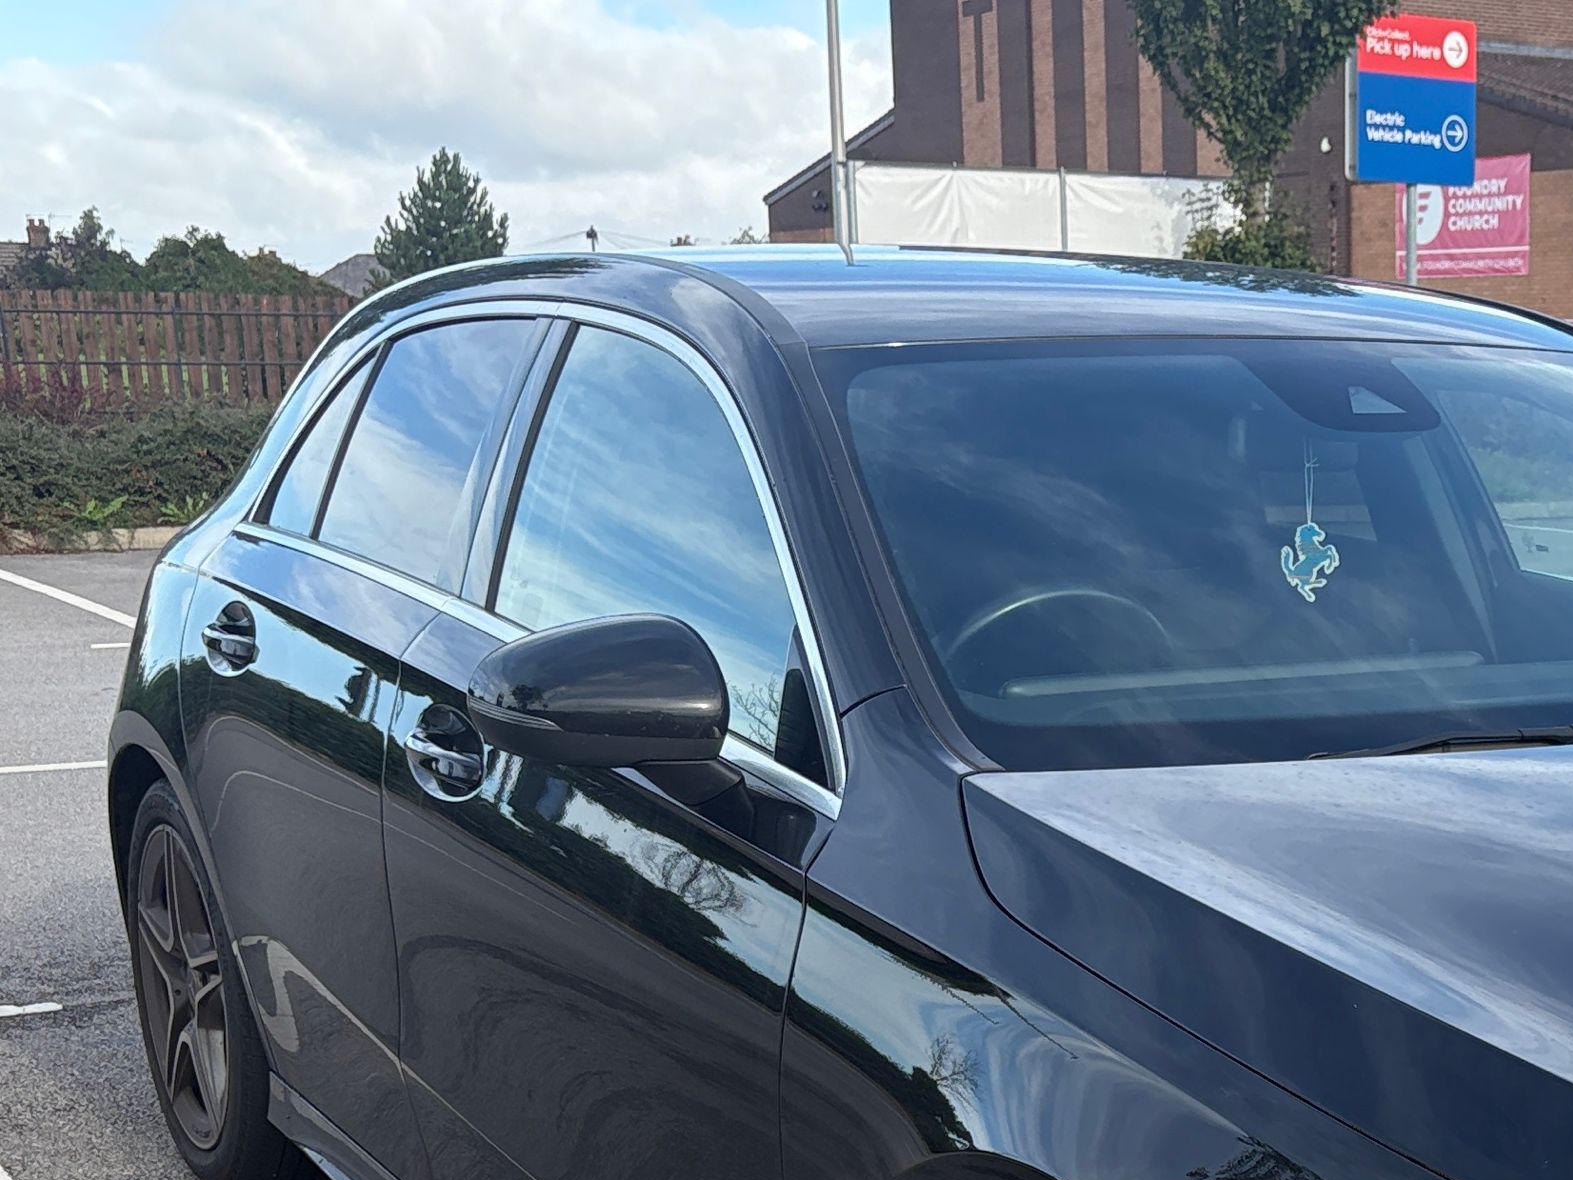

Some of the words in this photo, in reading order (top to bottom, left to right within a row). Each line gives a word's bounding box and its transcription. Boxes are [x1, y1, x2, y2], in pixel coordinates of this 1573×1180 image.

[1366, 37, 1392, 55] Pick
[1394, 42, 1411, 60] up
[1412, 41, 1441, 60] here
[1366, 109, 1405, 126] Electric
[1366, 126, 1403, 143] Vehicle
[1404, 128, 1442, 149] Parking
[1448, 194, 1524, 214] COMMUNITY
[1448, 214, 1499, 231] CHURCH
